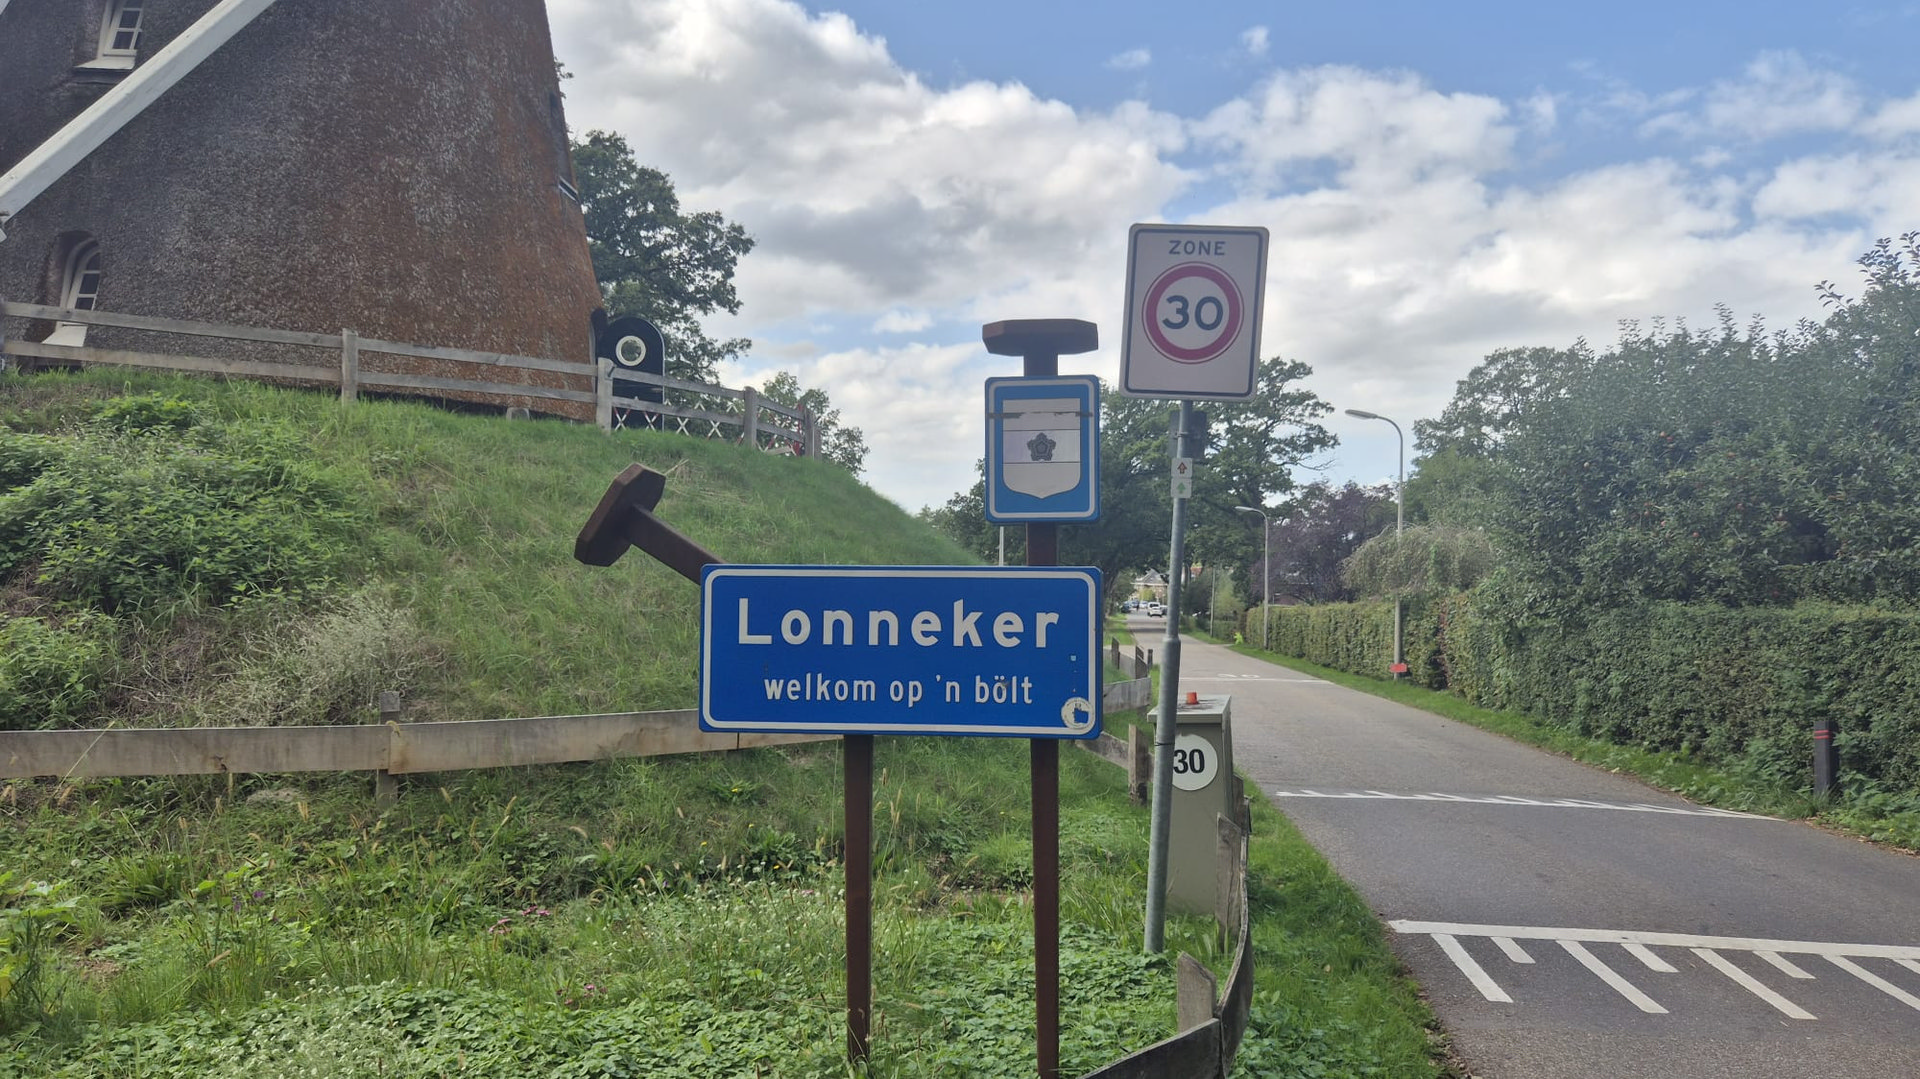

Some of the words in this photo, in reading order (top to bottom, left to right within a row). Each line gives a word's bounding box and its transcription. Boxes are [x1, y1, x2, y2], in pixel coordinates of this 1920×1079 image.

[1168, 240, 1226, 256] ZONE
[1162, 295, 1223, 331] 30
[738, 598, 1059, 648] Lonneker
[764, 673, 876, 702] welkom
[889, 679, 923, 708] op
[975, 675, 1033, 704] bölt
[1173, 748, 1205, 774] 30
